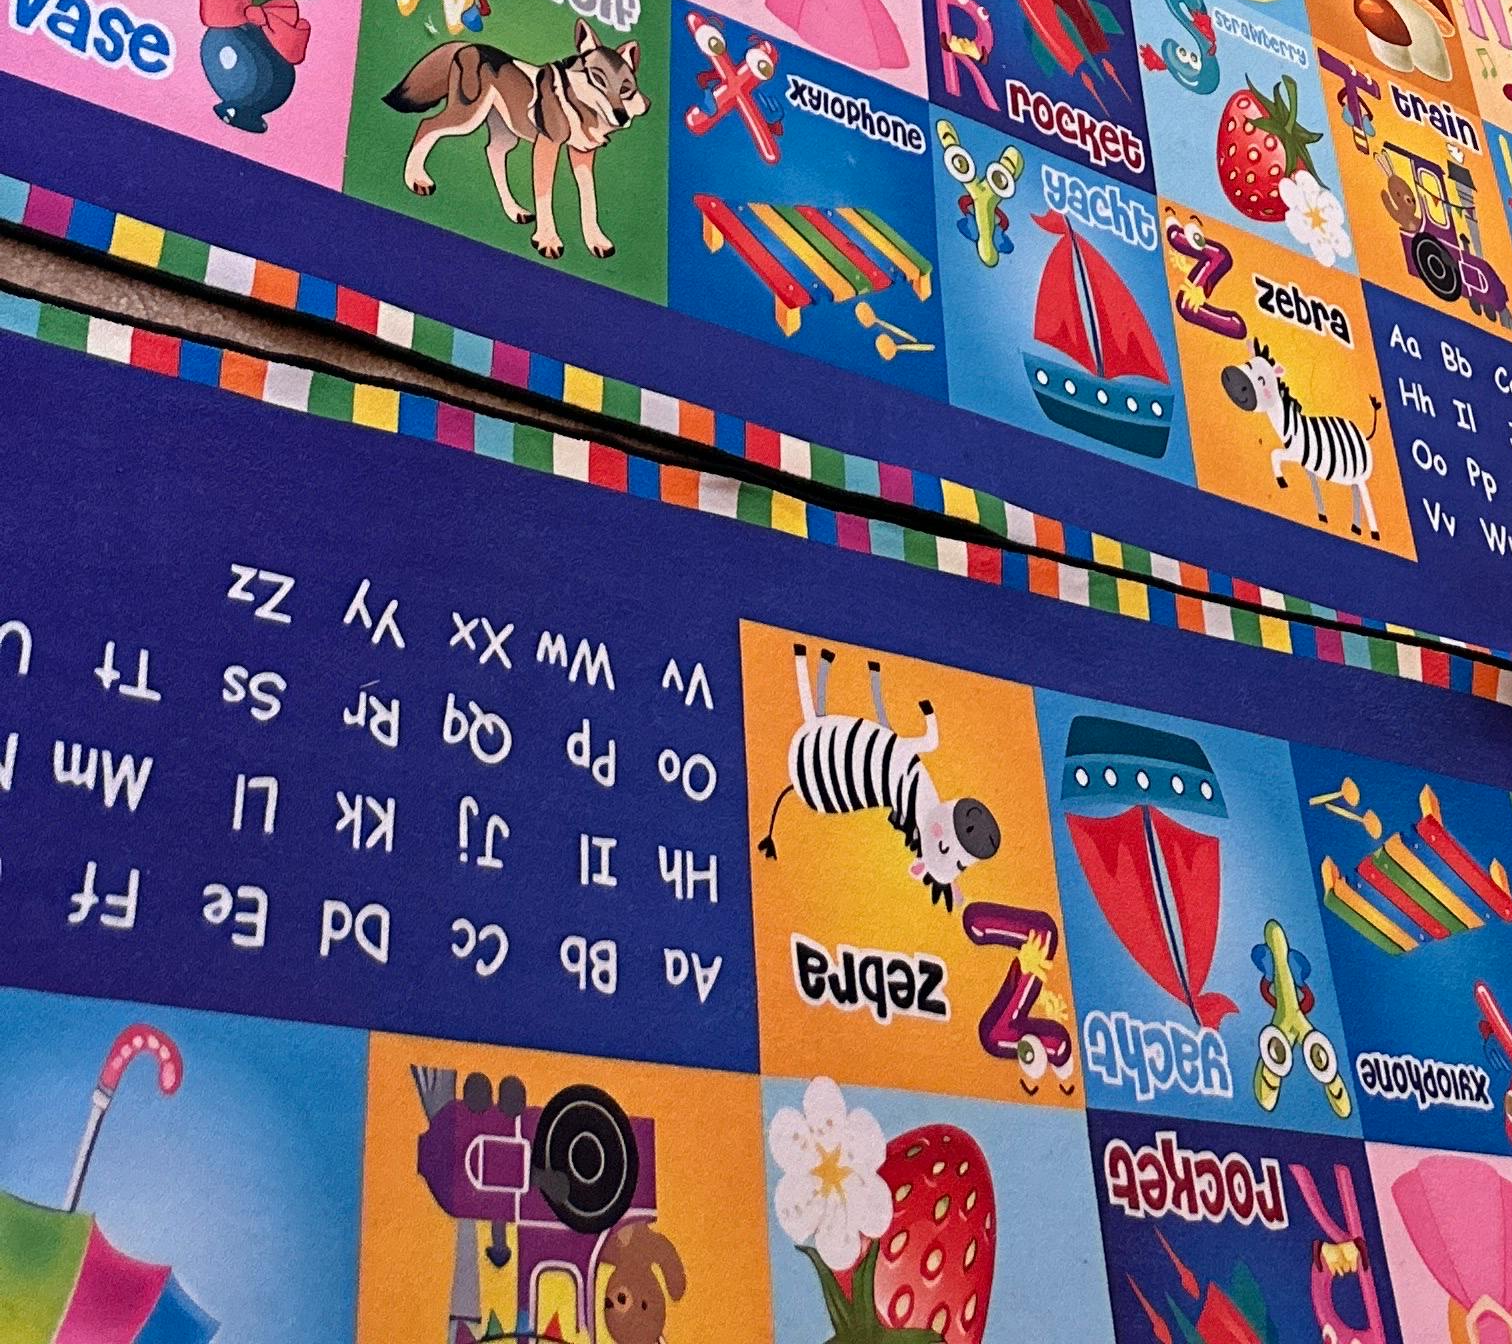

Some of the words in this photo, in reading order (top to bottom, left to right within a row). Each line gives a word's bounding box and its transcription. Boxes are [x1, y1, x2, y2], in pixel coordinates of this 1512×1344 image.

[1213, 9, 1309, 69] strawberry
[685, 13, 780, 164] X
[787, 76, 926, 153] xylophone
[1318, 49, 1380, 154] T
[1391, 85, 1481, 152] train
[1008, 80, 1147, 174] rocket
[935, 120, 1023, 267] Y
[1041, 165, 1159, 251] yacht
[1166, 210, 1246, 339] Z
[1255, 275, 1352, 346] zebra
[1390, 324, 1422, 360] Aa
[1440, 341, 1473, 378] Bb
[1398, 377, 1436, 418] Hh
[1411, 439, 1448, 476] Oo
[1466, 456, 1498, 502] Pp
[1422, 498, 1456, 537] Vv
[227, 563, 295, 624] Zz
[343, 578, 405, 649] Yy
[94, 641, 162, 701] Tt
[449, 612, 515, 670] Xx
[536, 630, 615, 691] Ww
[222, 665, 287, 721] Ss
[662, 658, 714, 710] Vv
[343, 691, 400, 748] Rr
[442, 692, 512, 764] Qq
[53, 740, 154, 812] Mm
[566, 718, 616, 787] Pp
[658, 749, 717, 802] Oo
[232, 774, 278, 834] Ll
[335, 791, 396, 853] Kk
[459, 796, 510, 869] Jj
[68, 861, 140, 928] Ff
[658, 845, 718, 903] Hh
[203, 883, 268, 947] Ee
[319, 900, 390, 964] Dd
[451, 918, 509, 977] Cc
[560, 935, 617, 995] Bb
[663, 948, 723, 1004] Aa
[795, 935, 949, 1019] zebra
[963, 903, 1074, 1082] Z
[1253, 919, 1353, 1118] Y
[1085, 1012, 1232, 1099] yacht
[1360, 1053, 1492, 1111] xylophone
[1107, 1132, 1288, 1228] rocket
